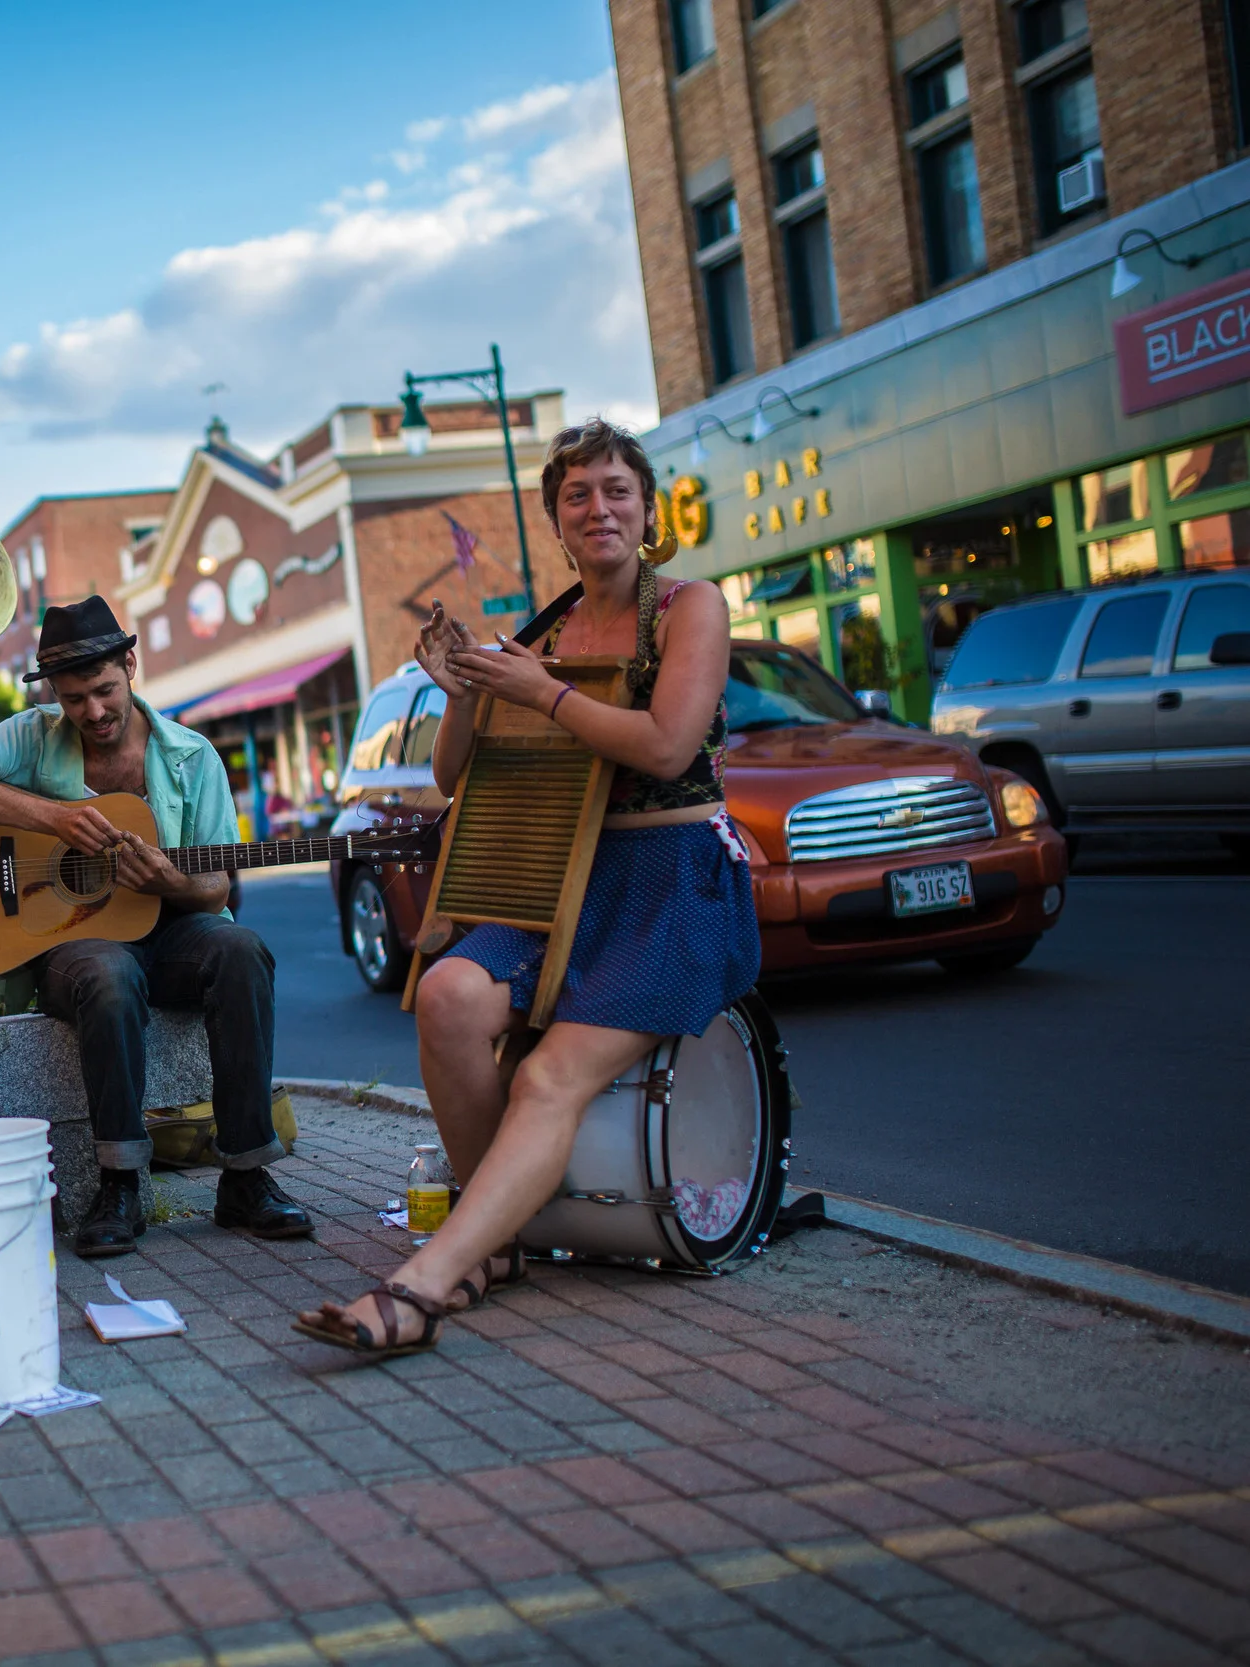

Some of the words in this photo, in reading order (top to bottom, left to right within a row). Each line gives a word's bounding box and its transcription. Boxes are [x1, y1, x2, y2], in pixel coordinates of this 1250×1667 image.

[744, 447, 822, 501] BAR
[744, 488, 831, 541] CAFE
[918, 877, 947, 902] 916
[950, 874, 970, 898] SZ
